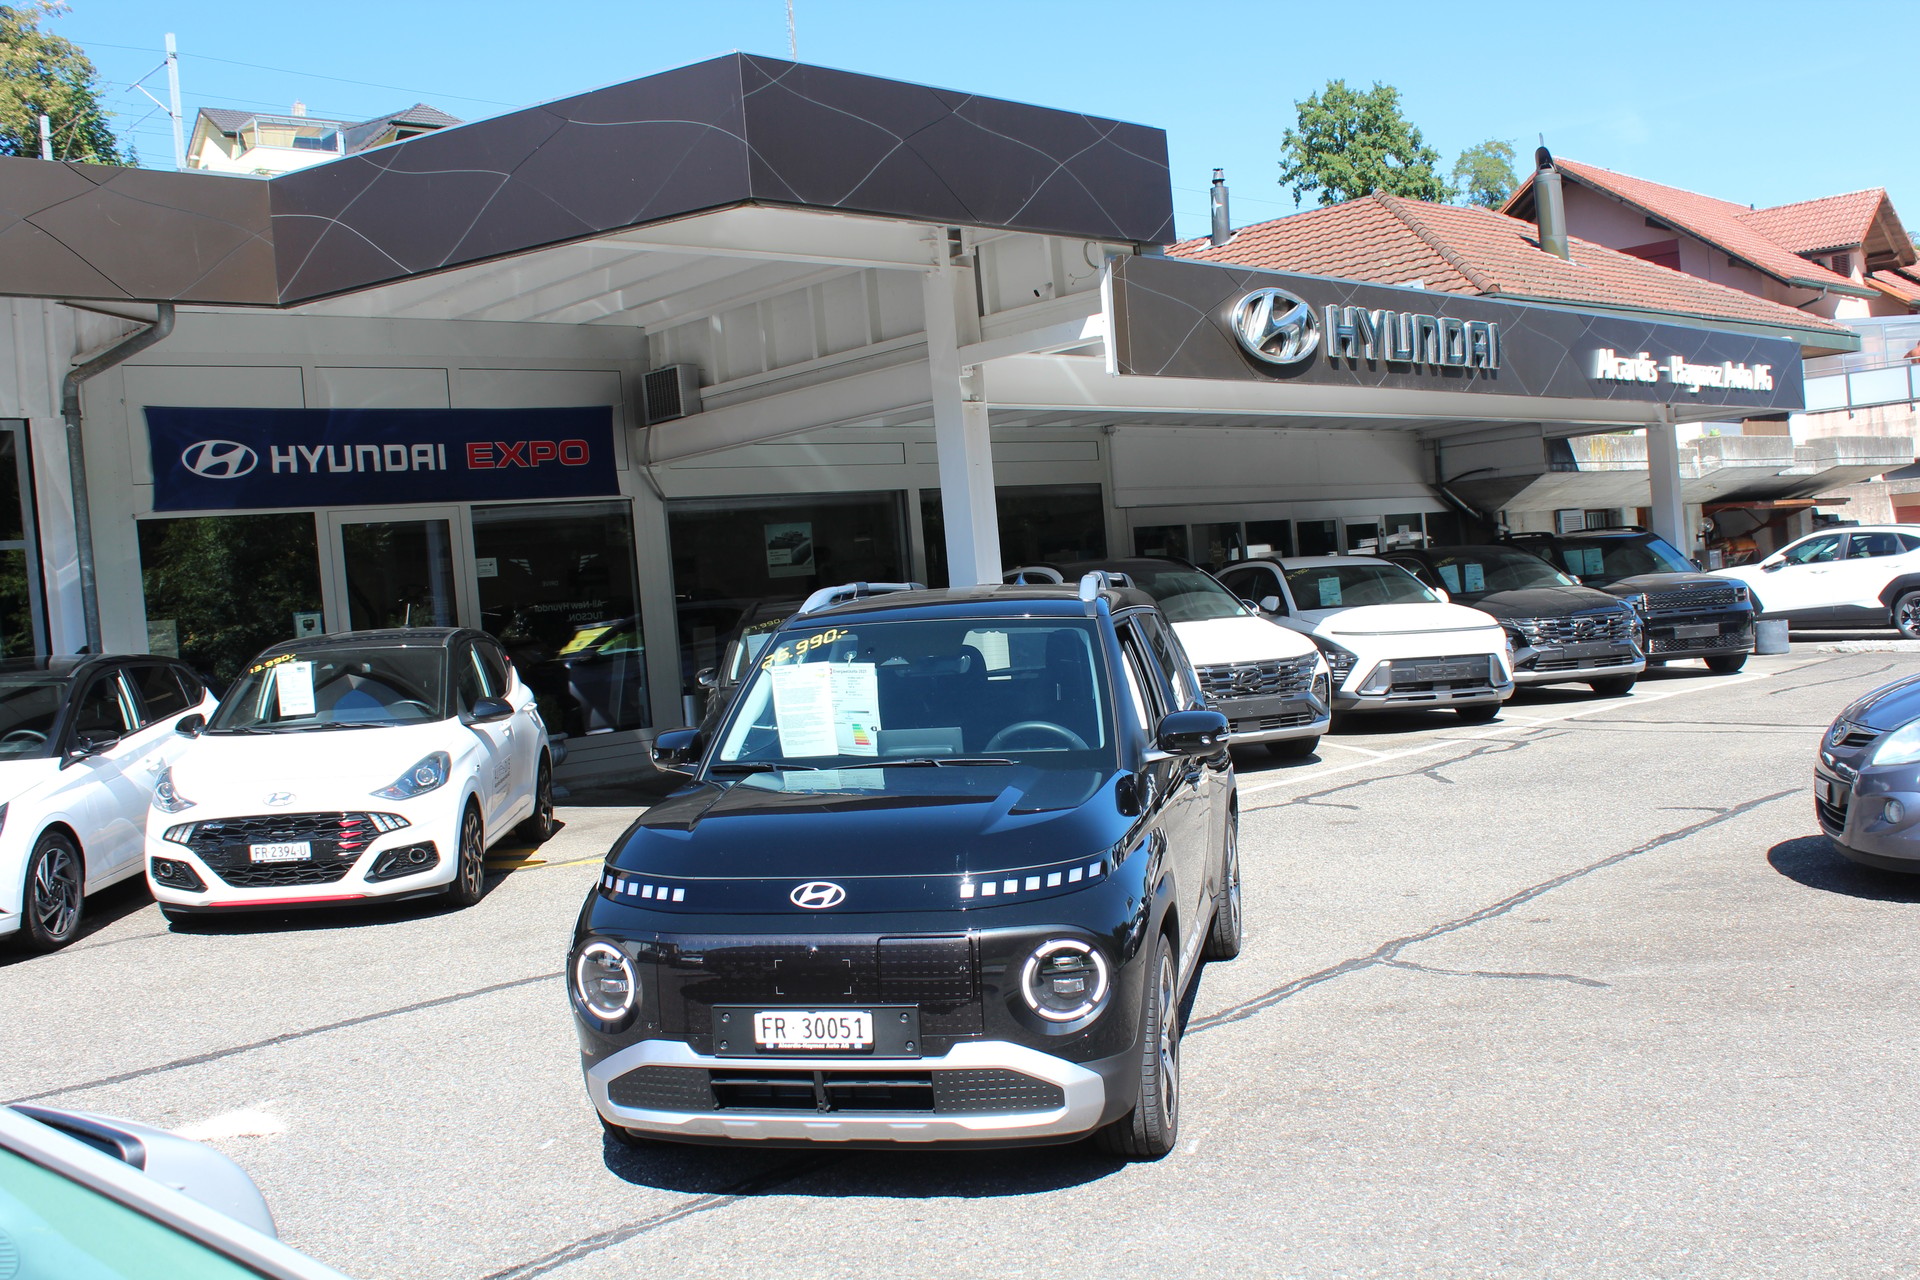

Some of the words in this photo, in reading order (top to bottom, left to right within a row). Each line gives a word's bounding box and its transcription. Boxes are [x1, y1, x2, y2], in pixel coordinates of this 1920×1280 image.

[1325, 303, 1500, 370] HYUNDAI
[271, 444, 446, 473] HYUNDAI
[466, 439, 590, 469] EXPO
[255, 847, 267, 858] FR
[272, 845, 297, 857] 2394
[762, 1017, 786, 1039] FR
[802, 1017, 864, 1039] 30051
